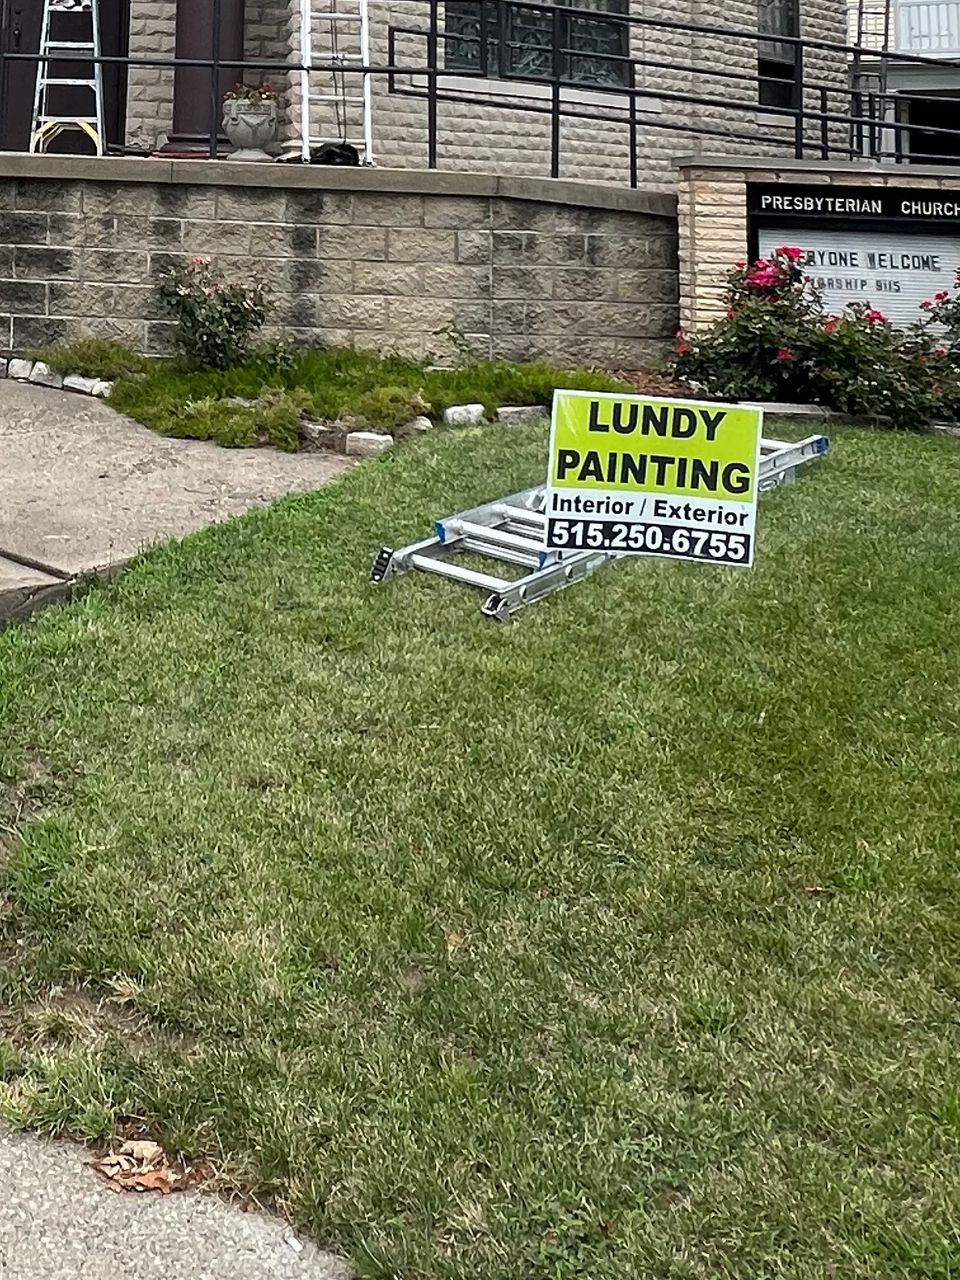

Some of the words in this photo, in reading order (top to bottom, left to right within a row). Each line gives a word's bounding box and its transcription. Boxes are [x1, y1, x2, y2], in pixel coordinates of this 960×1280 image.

[761, 195, 882, 214] PRESBYTERIAN
[901, 200, 960, 216] CHURCH
[866, 251, 941, 270] WELCOME
[588, 401, 728, 441] LUNDY
[556, 449, 751, 494] PAINTING
[551, 493, 634, 516] Interior
[653, 499, 750, 527] Exterior
[551, 521, 747, 560] 515.250.6755
